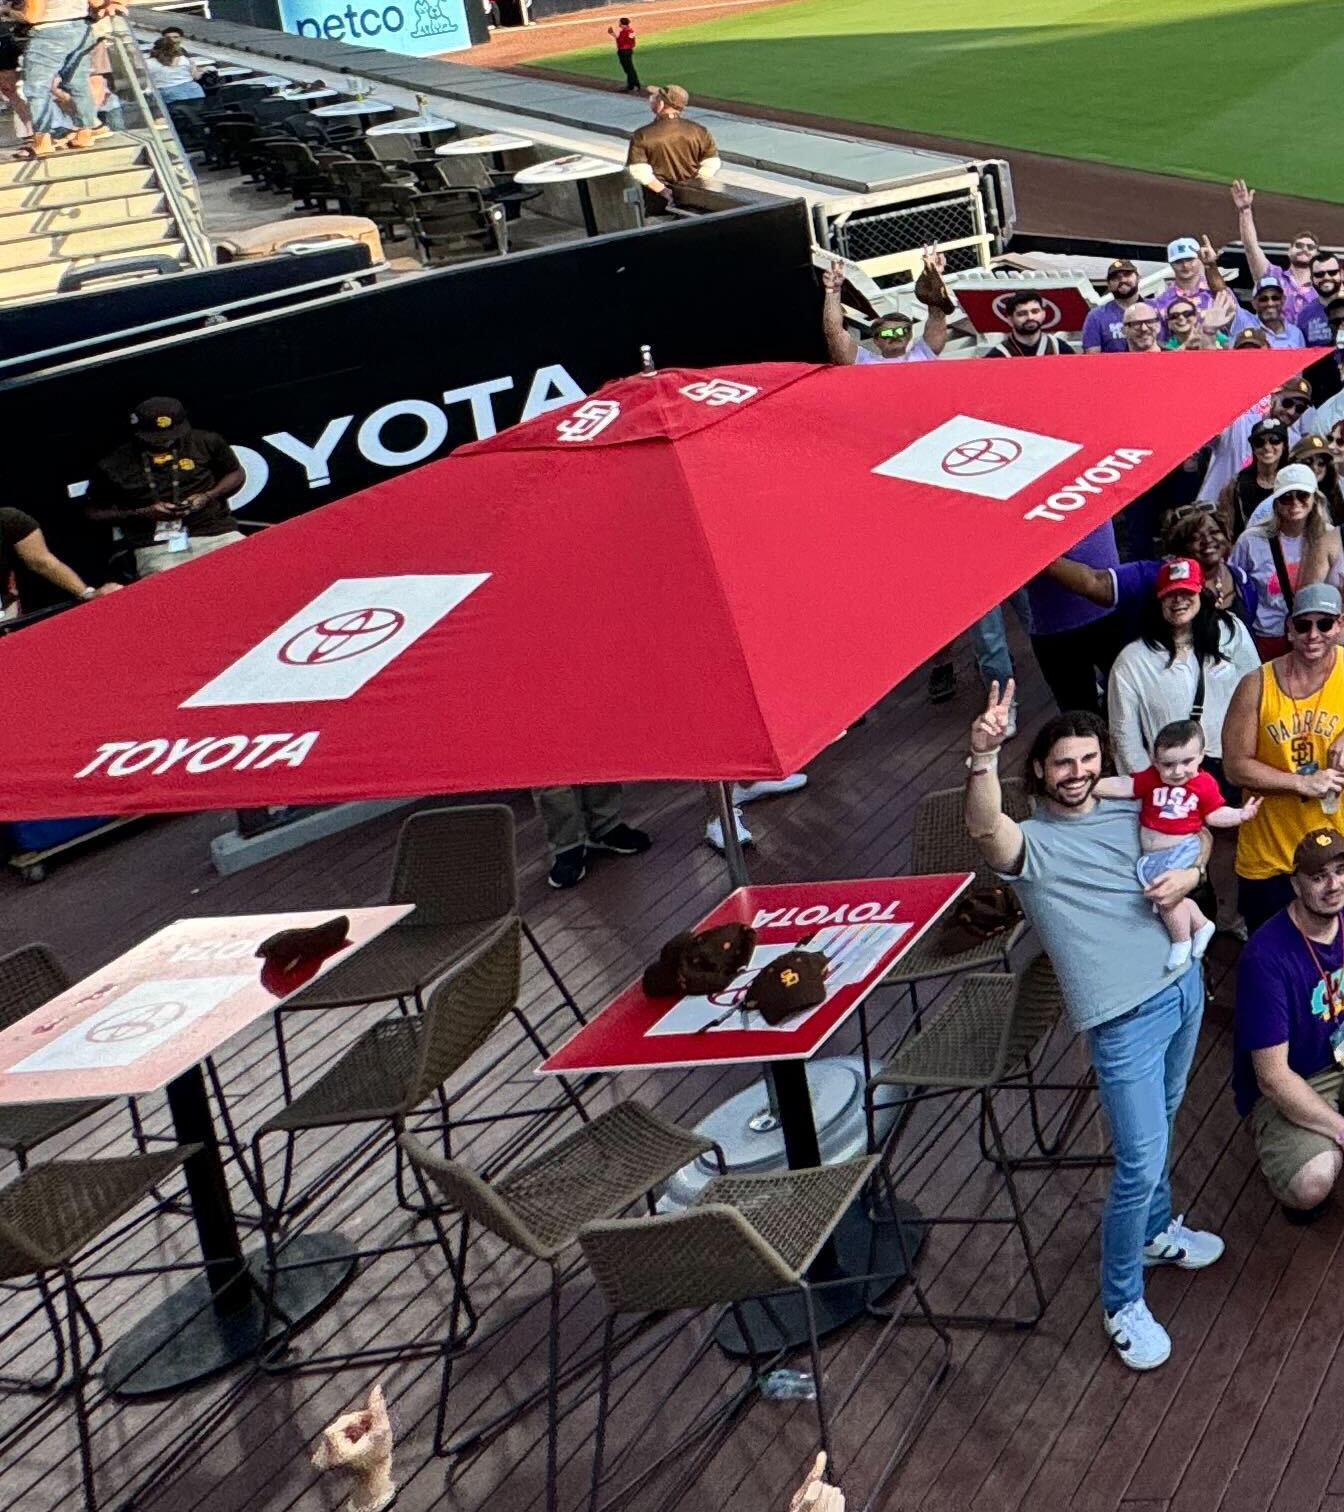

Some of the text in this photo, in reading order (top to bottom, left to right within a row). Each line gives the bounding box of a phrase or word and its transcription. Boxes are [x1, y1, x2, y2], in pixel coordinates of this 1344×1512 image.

[296, 4, 404, 41] petco
[1022, 448, 1154, 522] TOYOTA
[1266, 709, 1340, 745] PADRES
[73, 730, 321, 779] TOYOTA
[1152, 786, 1200, 813] USA
[752, 899, 901, 929] TOYOTA
